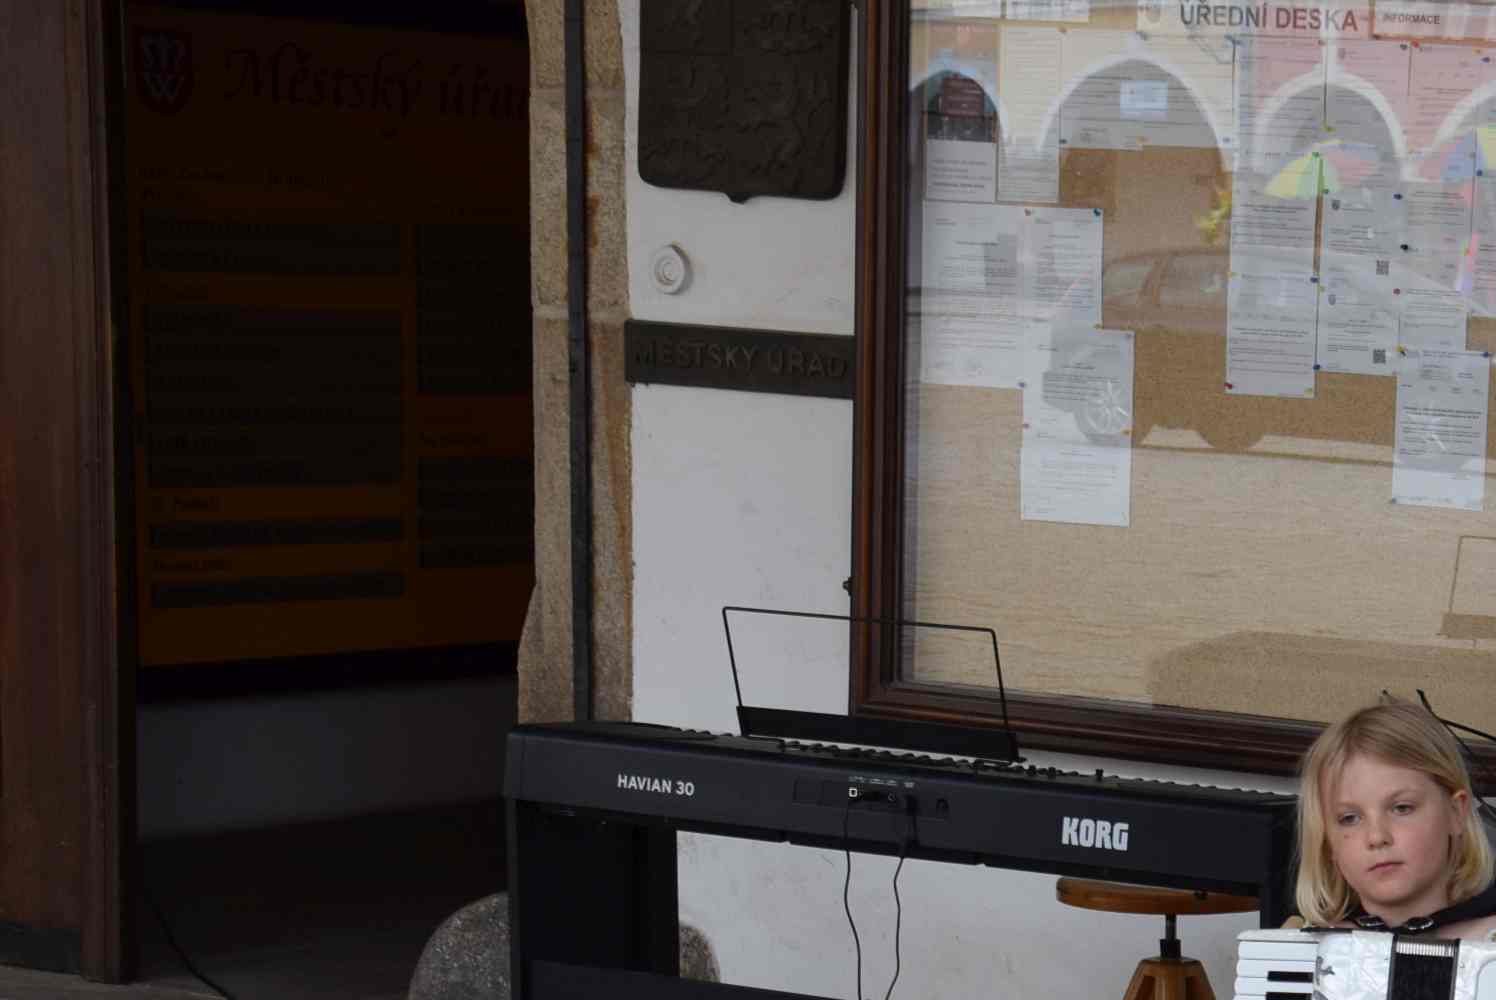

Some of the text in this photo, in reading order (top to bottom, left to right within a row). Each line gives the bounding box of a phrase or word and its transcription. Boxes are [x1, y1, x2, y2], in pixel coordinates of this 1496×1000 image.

[1275, 7, 1359, 32] DESKA
[616, 773, 695, 796] HAVIAN 30
[1061, 816, 1129, 851] KORG
